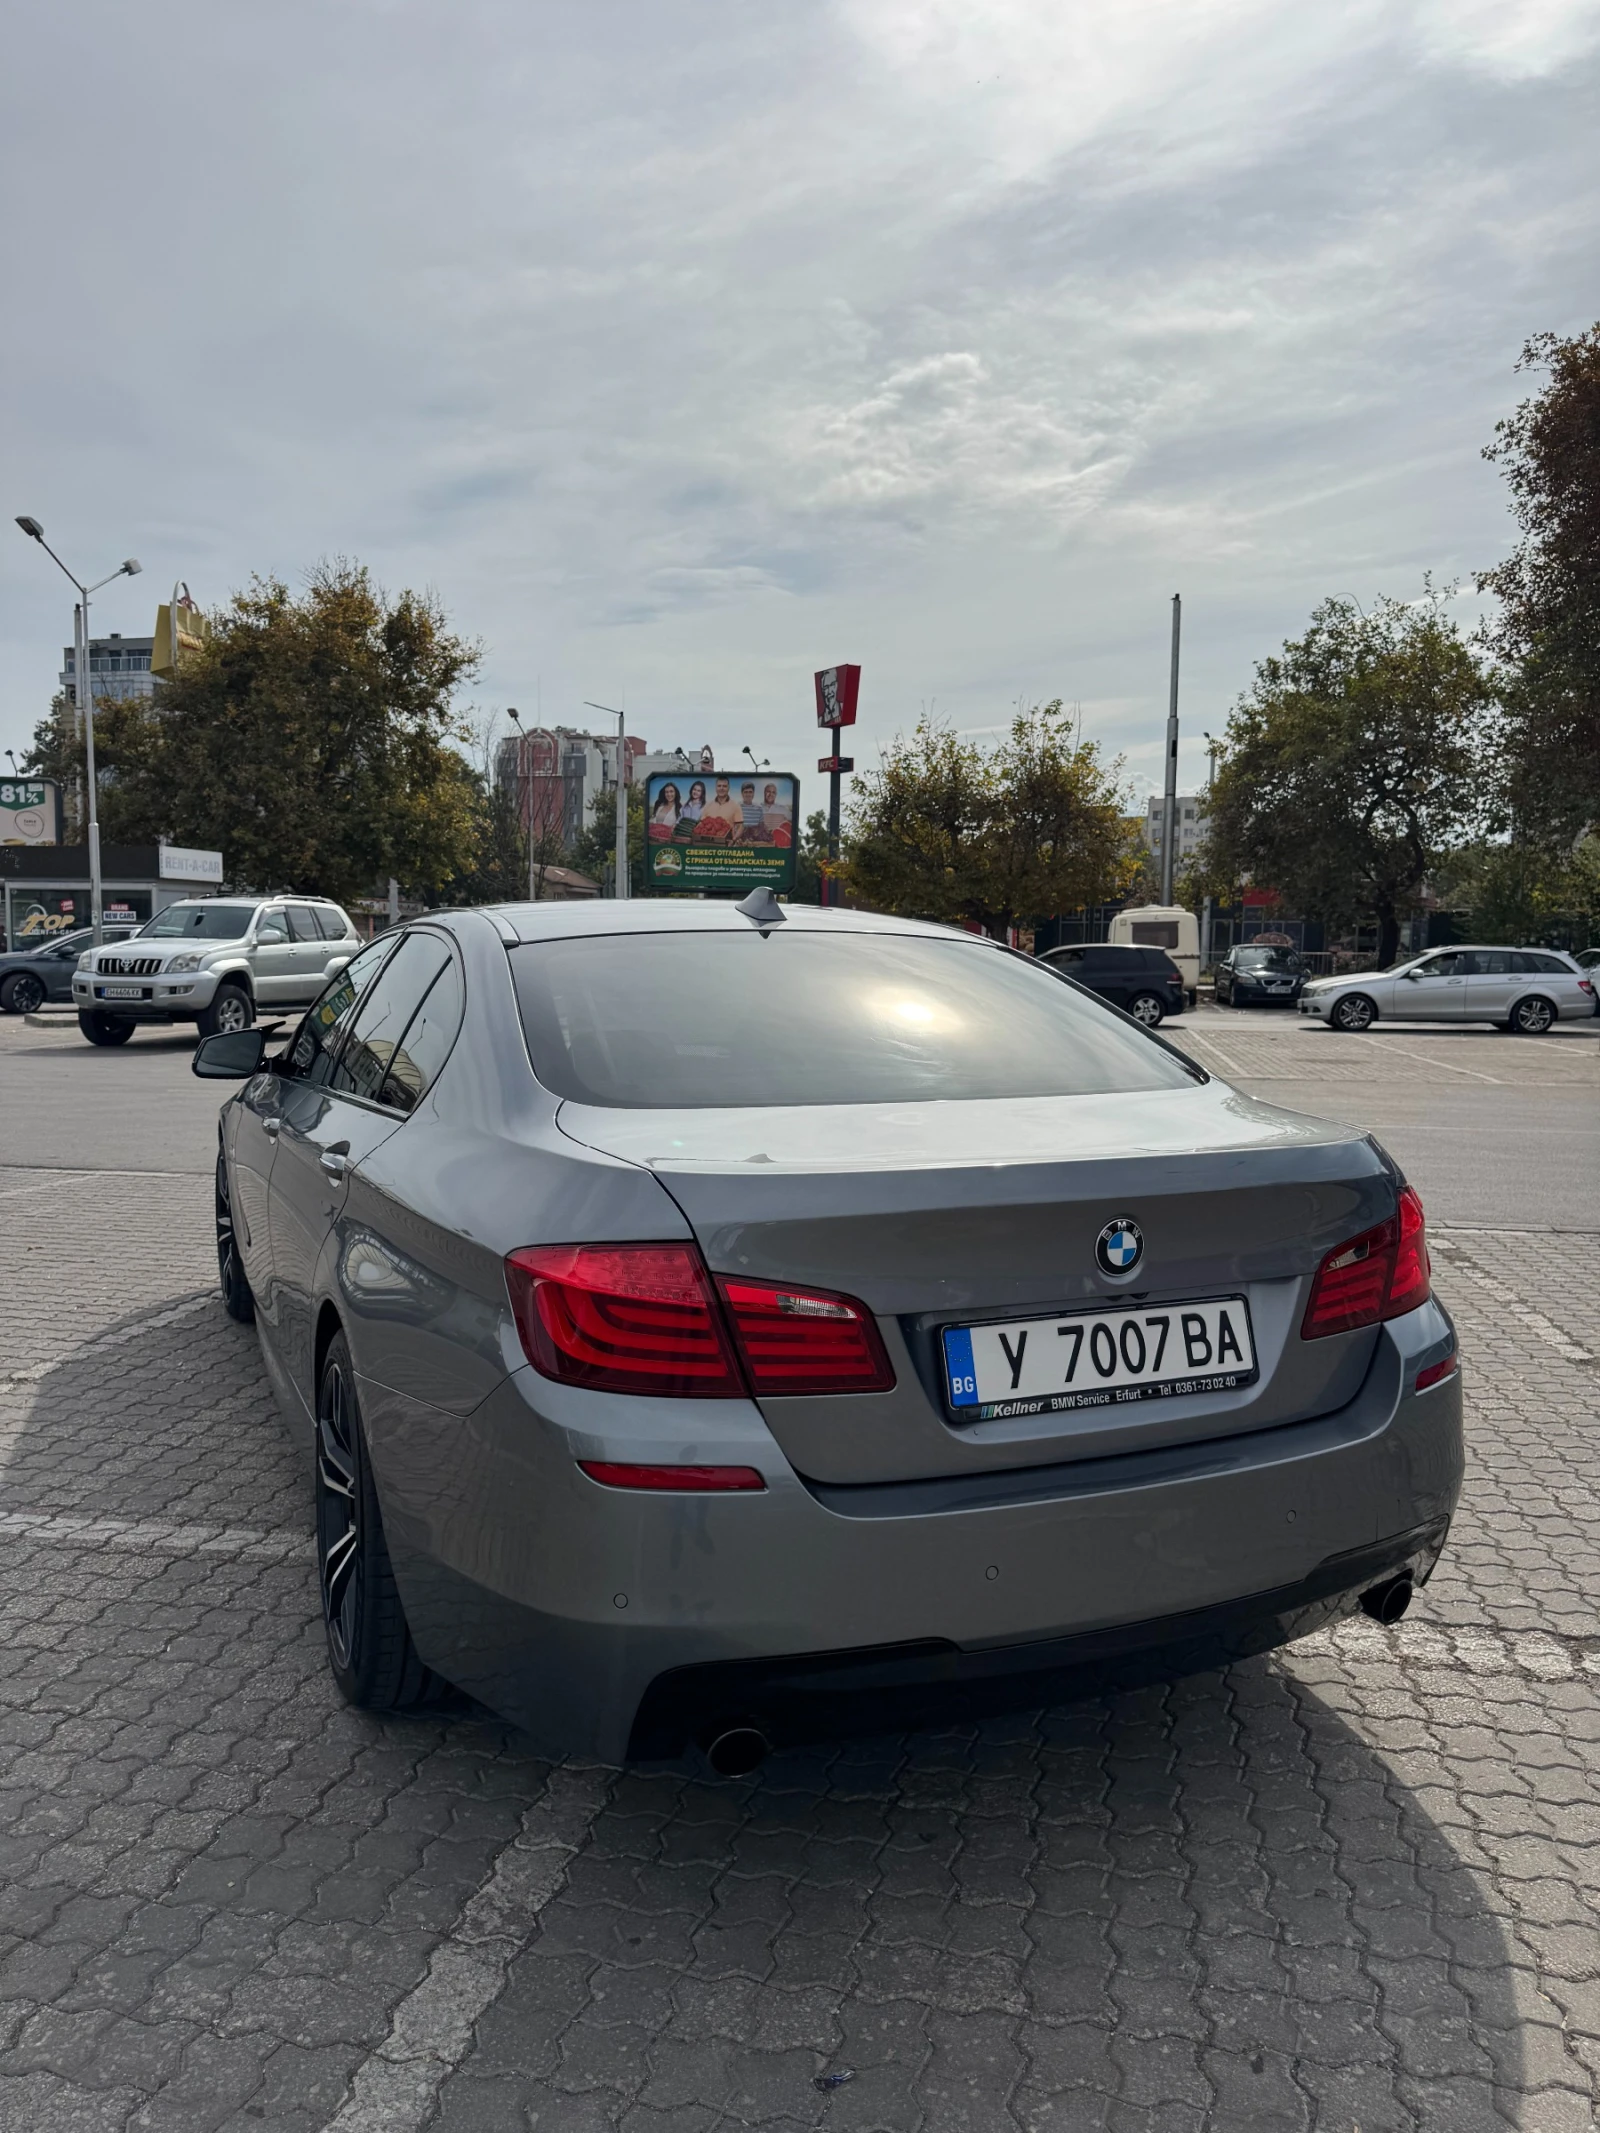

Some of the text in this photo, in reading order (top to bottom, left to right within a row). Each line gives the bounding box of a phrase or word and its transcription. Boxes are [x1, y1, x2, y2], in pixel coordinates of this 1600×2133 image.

[820, 760, 834, 769] KFC
[717, 849, 755, 857] ОТГЛЕДАНА
[165, 856, 220, 873] RENT-A-CAR
[22, 914, 75, 935] TOP
[1101, 1221, 1140, 1240] BMW
[998, 1310, 1243, 1389] Y 7007 BA
[953, 1376, 974, 1394] BG
[993, 1402, 1044, 1417] Kellner
[1051, 1396, 1076, 1410] BMW
[1077, 1393, 1110, 1406] Service
[1116, 1388, 1141, 1401] Erfurt
[1158, 1383, 1172, 1396] Tel
